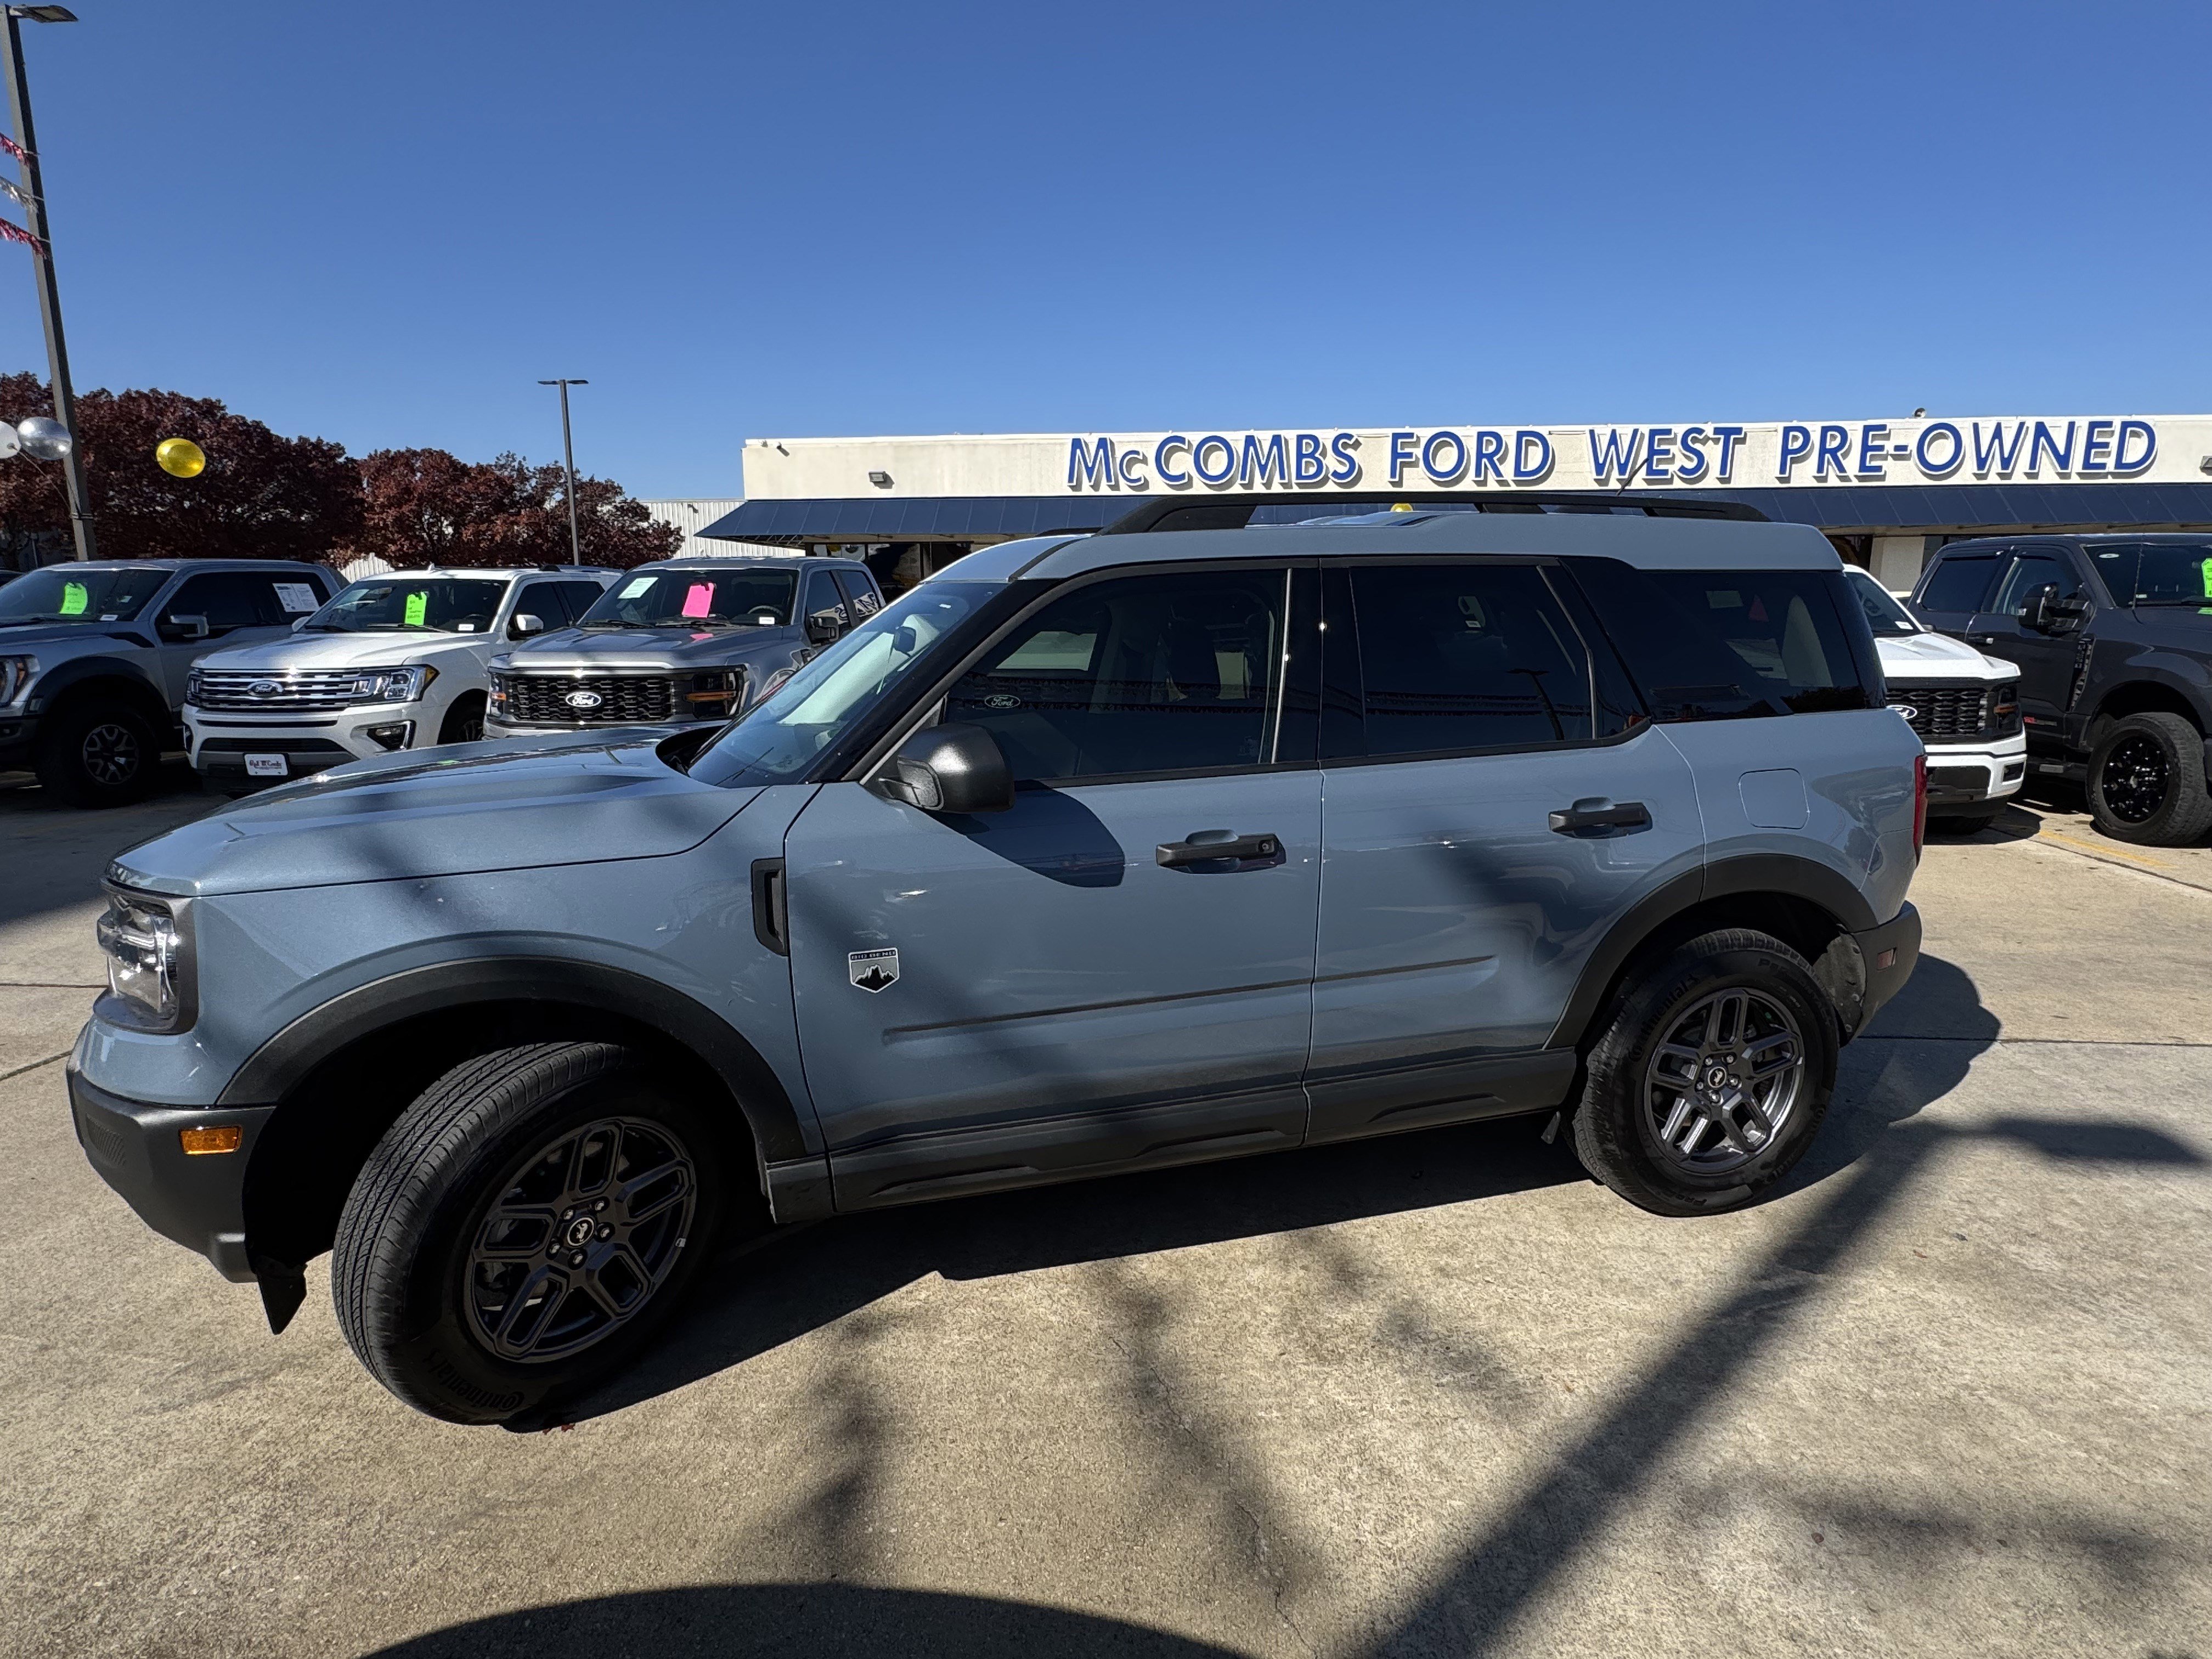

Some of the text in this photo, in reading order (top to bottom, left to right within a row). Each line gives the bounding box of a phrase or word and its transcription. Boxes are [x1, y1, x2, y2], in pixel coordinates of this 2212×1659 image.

[1067, 420, 2158, 486] McCOMBS FORD WEST PRE-OWNED
